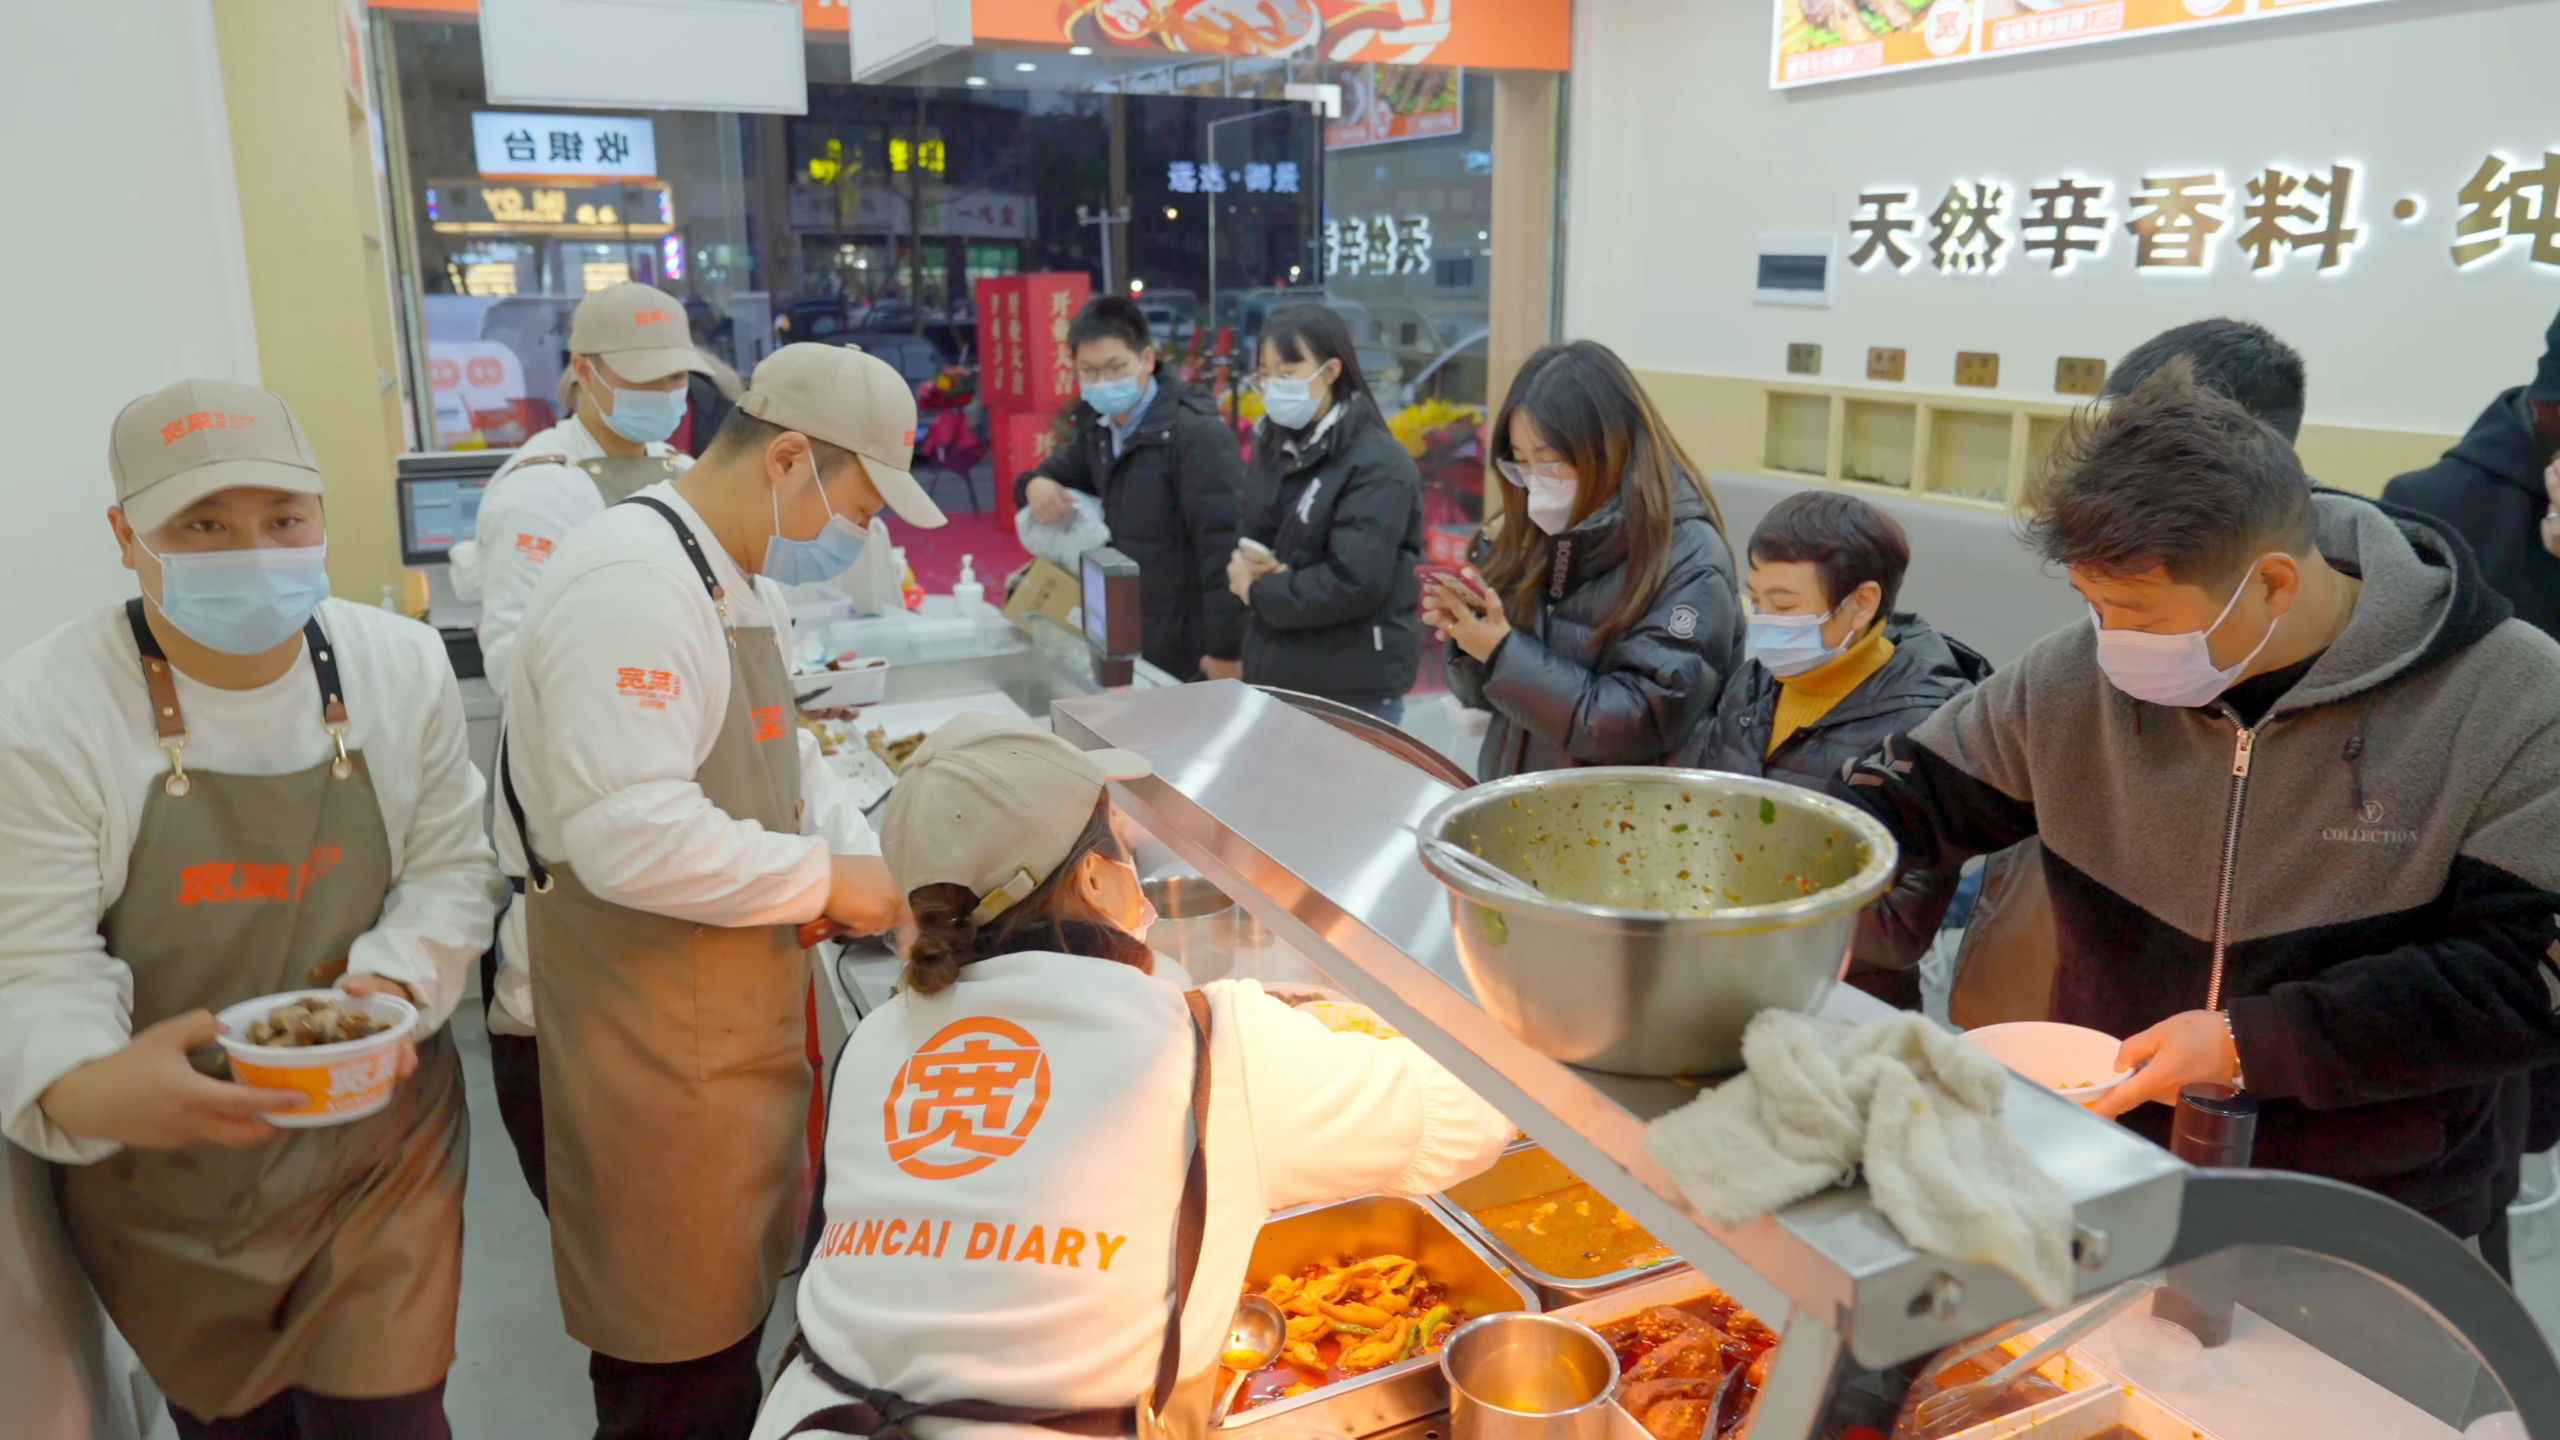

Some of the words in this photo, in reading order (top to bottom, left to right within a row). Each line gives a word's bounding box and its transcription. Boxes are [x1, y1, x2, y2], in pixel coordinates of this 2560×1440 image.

[2322, 827, 2418, 843] COLLECTION
[887, 1036, 1045, 1164] 宽
[964, 1221, 1129, 1271] DIARY
